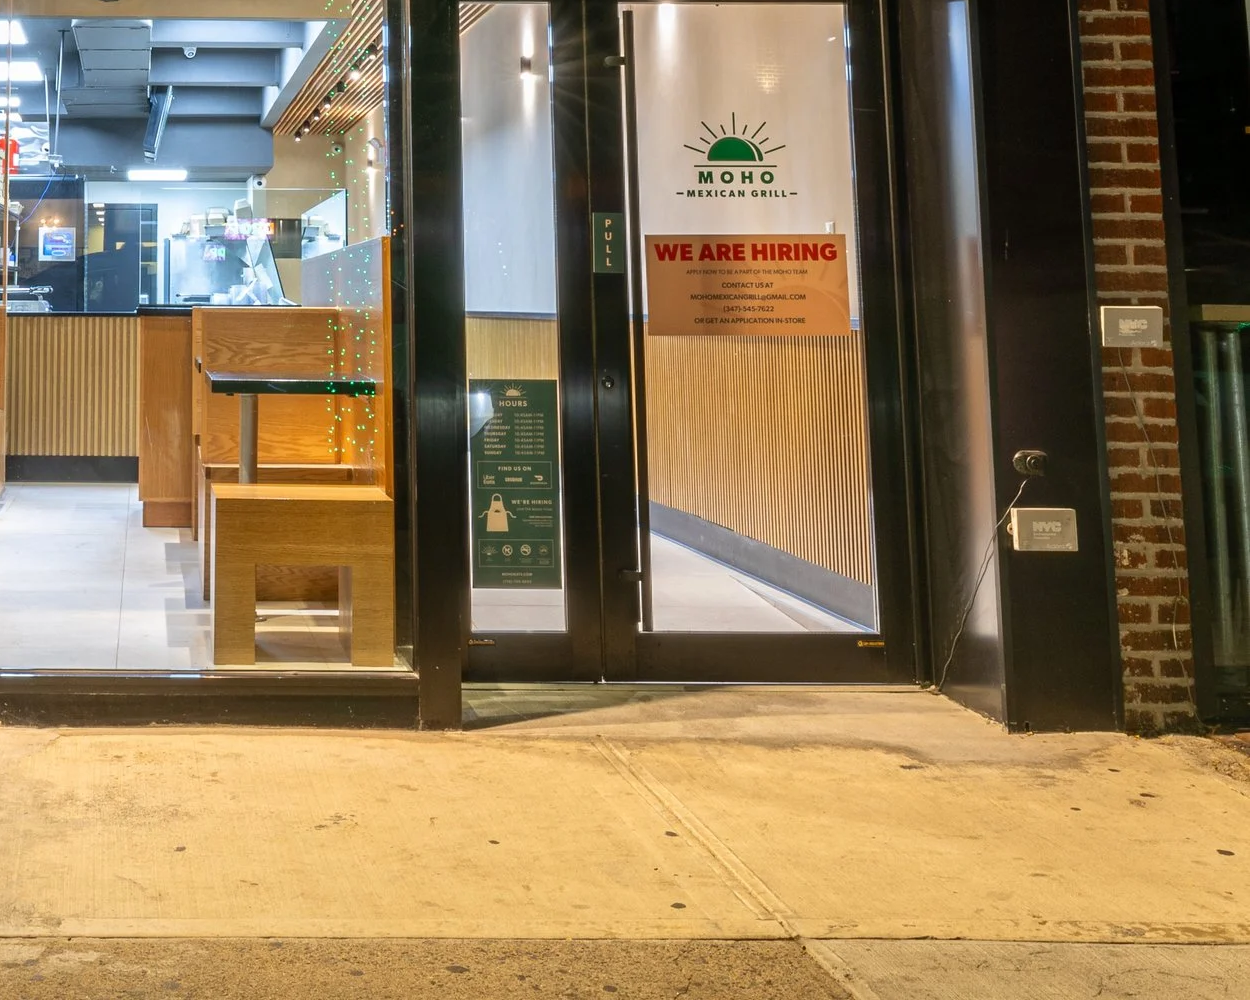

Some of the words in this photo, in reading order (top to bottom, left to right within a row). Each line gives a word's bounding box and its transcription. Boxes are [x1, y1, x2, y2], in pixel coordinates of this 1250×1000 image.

[698, 171, 774, 184] MOHO
[686, 189, 745, 198] MEXICAN
[751, 189, 787, 198] GRILL
[604, 219, 612, 267] PULL
[654, 243, 693, 262] WE
[698, 243, 746, 262] ARE
[751, 243, 838, 262] HIRING
[690, 293, 806, 301] MOHOMEXICANGRILL@GMAIL.COM
[1032, 521, 1062, 532] NYC
